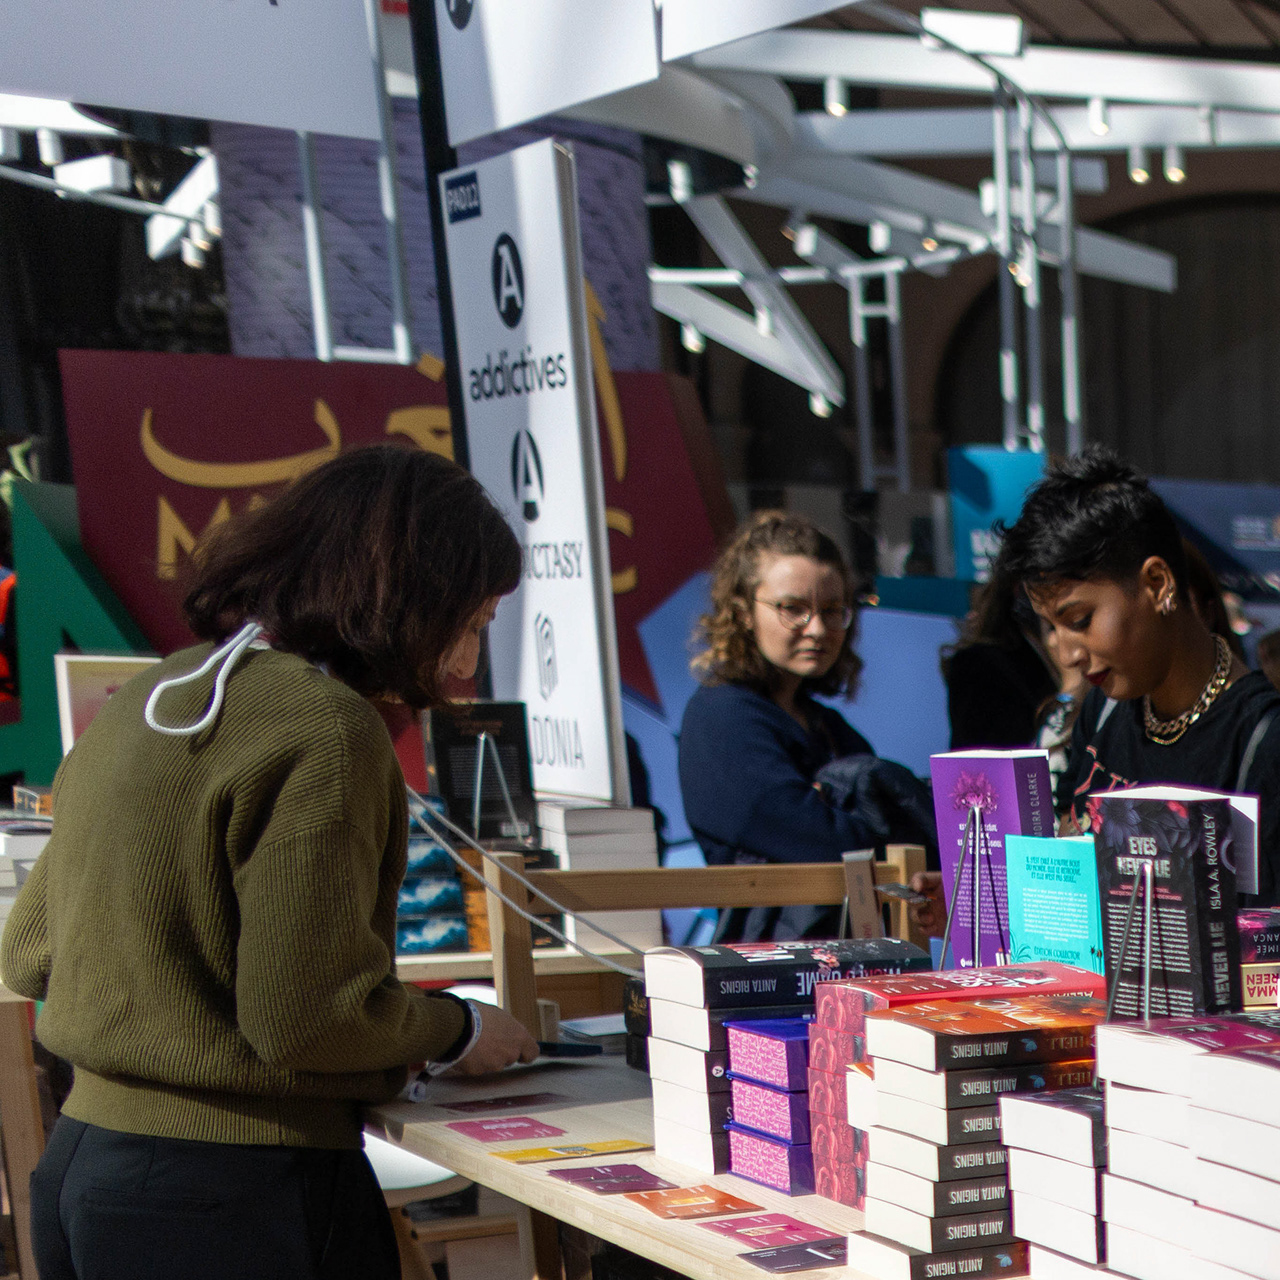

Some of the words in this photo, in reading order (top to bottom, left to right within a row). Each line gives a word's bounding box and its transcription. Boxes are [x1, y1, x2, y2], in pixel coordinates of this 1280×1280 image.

[469, 345, 567, 401] addictives
[1027, 773, 1039, 806] CLARKE
[1129, 836, 1158, 857] EYES
[1203, 814, 1218, 866] ROWLEY
[1154, 859, 1172, 879] LIE
[1207, 869, 1220, 881] A.
[1208, 885, 1222, 910] ISLA
[1209, 922, 1225, 947] LIE
[1052, 948, 1081, 960] COLLECTOR
[752, 979, 777, 992] ANITA
[1211, 951, 1231, 1006] NEVER
[720, 980, 750, 995] RIGINS
[1246, 984, 1279, 998] MMA
[952, 1044, 982, 1060] RIGINS
[984, 1042, 1009, 1056] ANITA
[960, 1080, 991, 1096] RIGINS
[992, 1078, 1018, 1092] ANITA
[962, 1117, 993, 1133] RIGINS
[953, 1152, 984, 1169] RIGINS
[985, 1149, 1009, 1166] ANITA
[949, 1188, 980, 1205] RIGINS
[981, 1186, 1006, 1202] ANITA
[946, 1224, 978, 1241] RIGINS
[978, 1221, 1004, 1236] ANITA
[926, 1262, 956, 1278] RIGINS
[958, 1258, 984, 1272] ANITA
